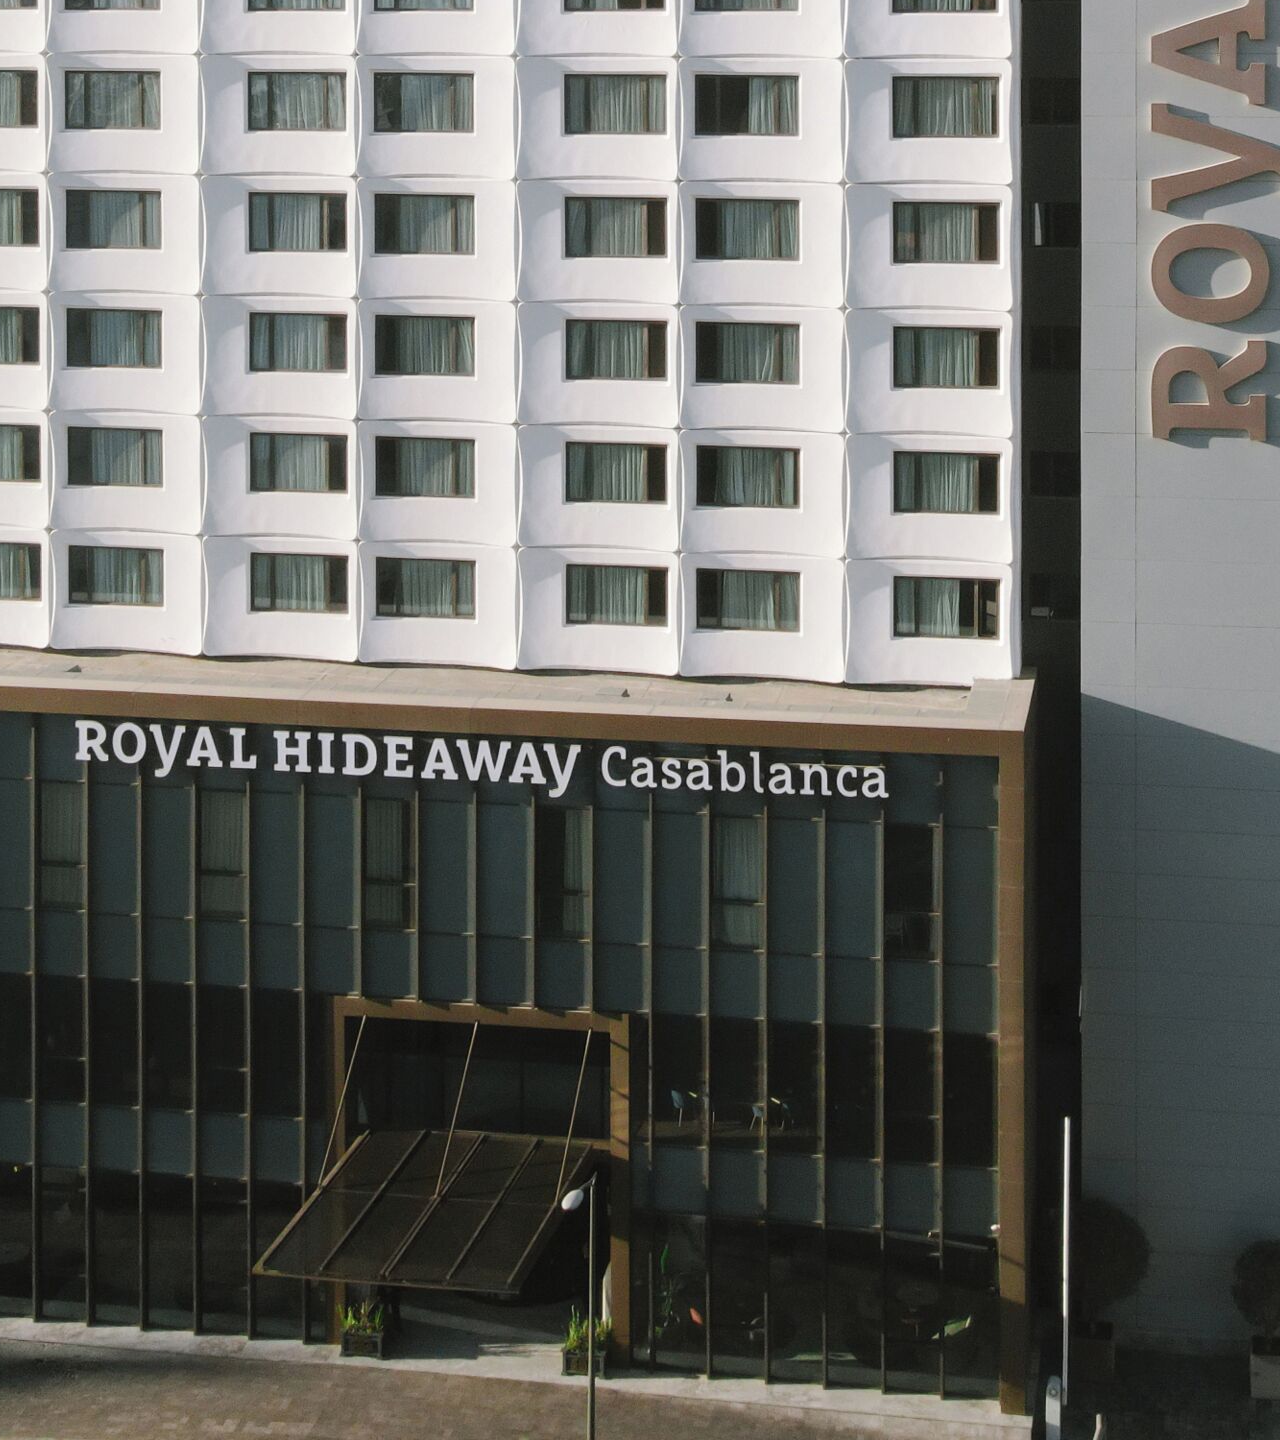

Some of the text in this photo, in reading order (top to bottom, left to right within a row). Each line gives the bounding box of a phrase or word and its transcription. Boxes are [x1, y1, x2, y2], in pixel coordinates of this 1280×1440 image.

[74, 719, 890, 799] ROYAL HIDEAWAY Casablanca
